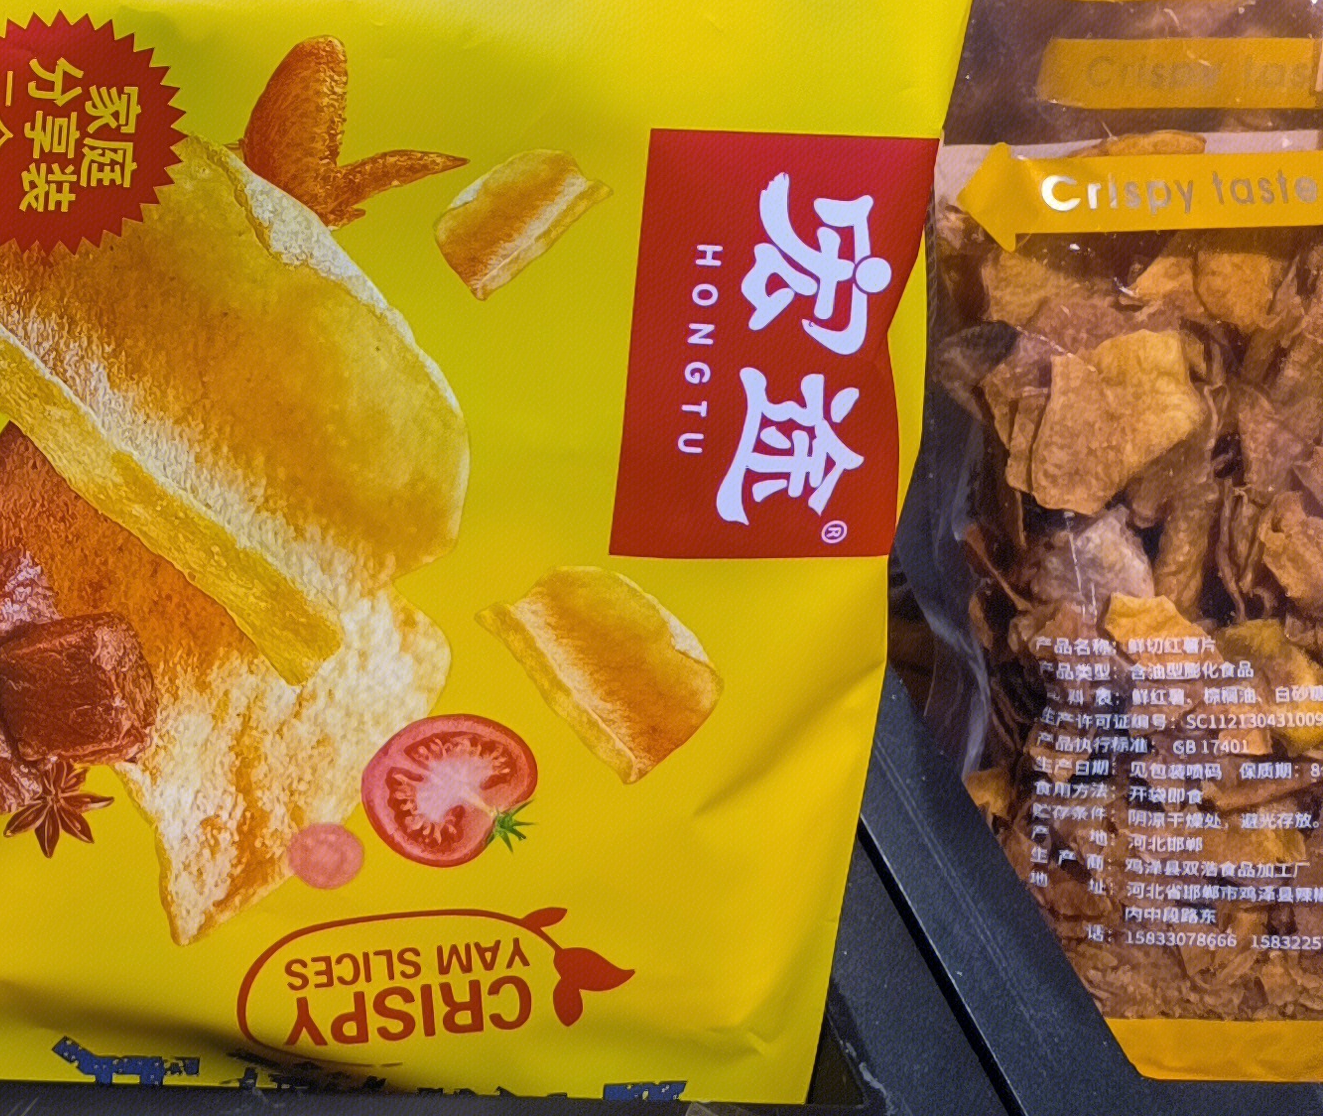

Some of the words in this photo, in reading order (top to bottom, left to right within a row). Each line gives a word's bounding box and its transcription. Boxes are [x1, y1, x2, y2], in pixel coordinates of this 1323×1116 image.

[1041, 171, 1194, 216] Crispy
[677, 244, 723, 454] HONGTU
[716, 171, 892, 525] 宏途
[284, 946, 421, 991] SLICES
[437, 936, 530, 977] YAM
[284, 975, 533, 1046] CRISPY
